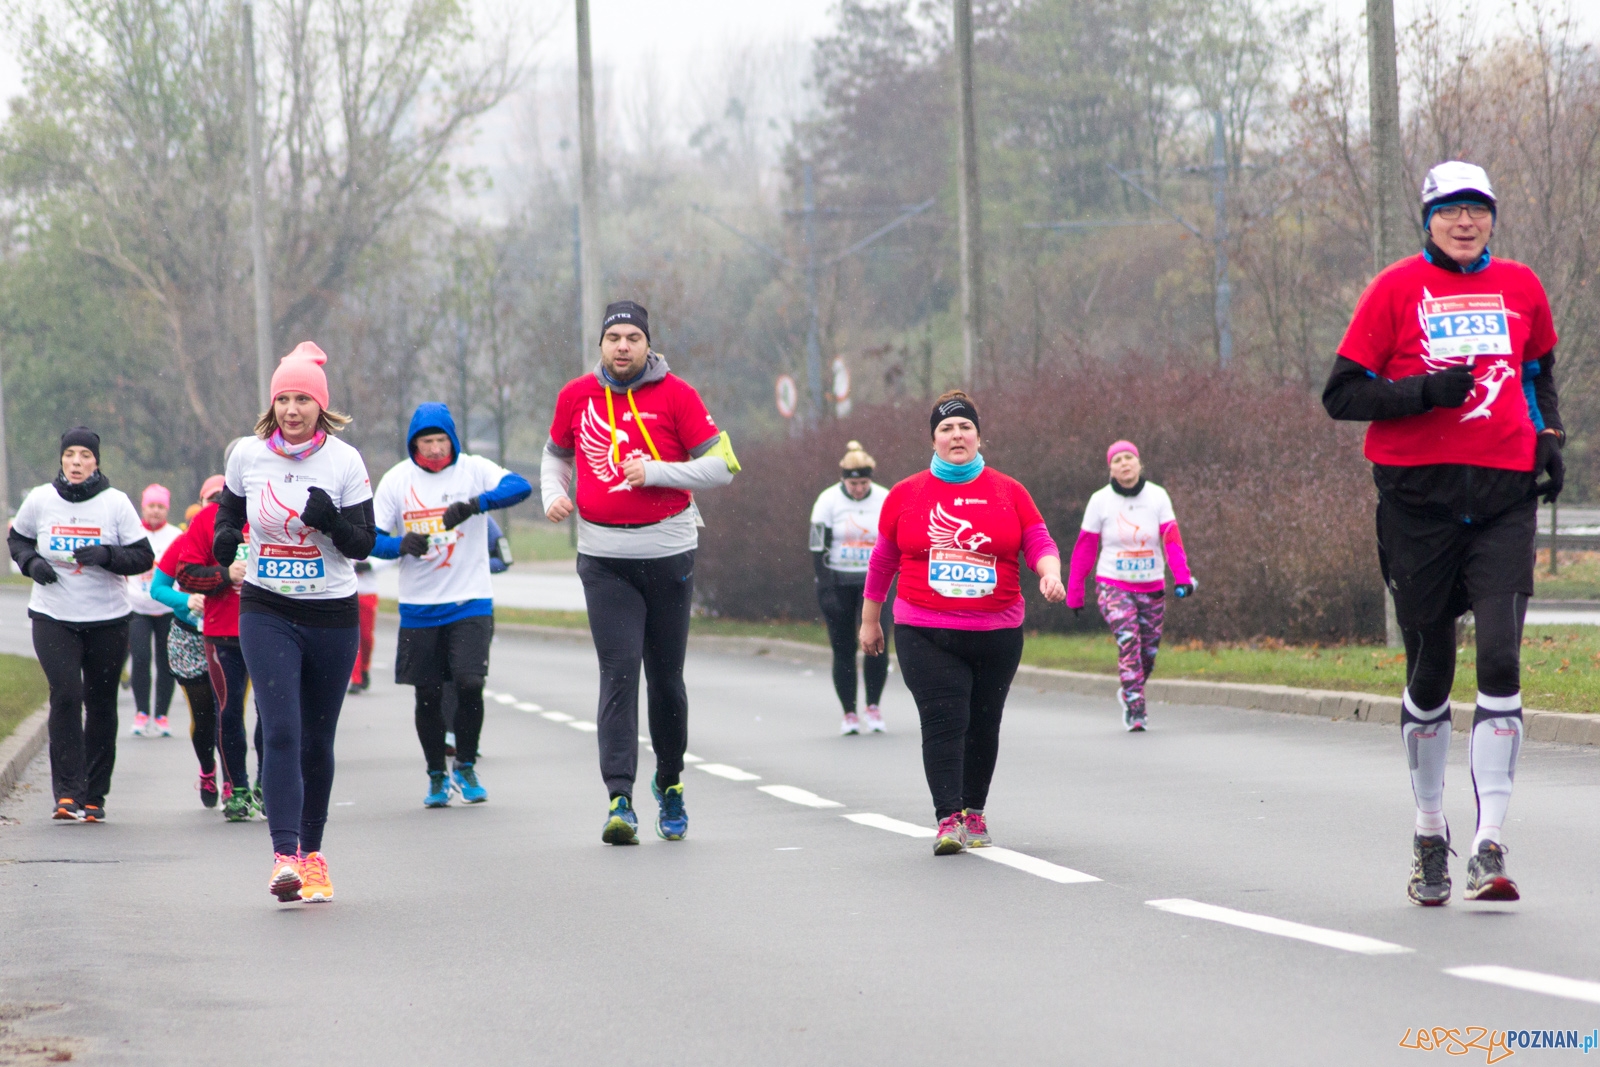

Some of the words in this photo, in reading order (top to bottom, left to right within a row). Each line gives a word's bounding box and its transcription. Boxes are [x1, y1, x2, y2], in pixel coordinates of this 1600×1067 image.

[1440, 314, 1500, 336] 1235
[266, 560, 318, 578] 8286
[938, 564, 990, 582] 2049
